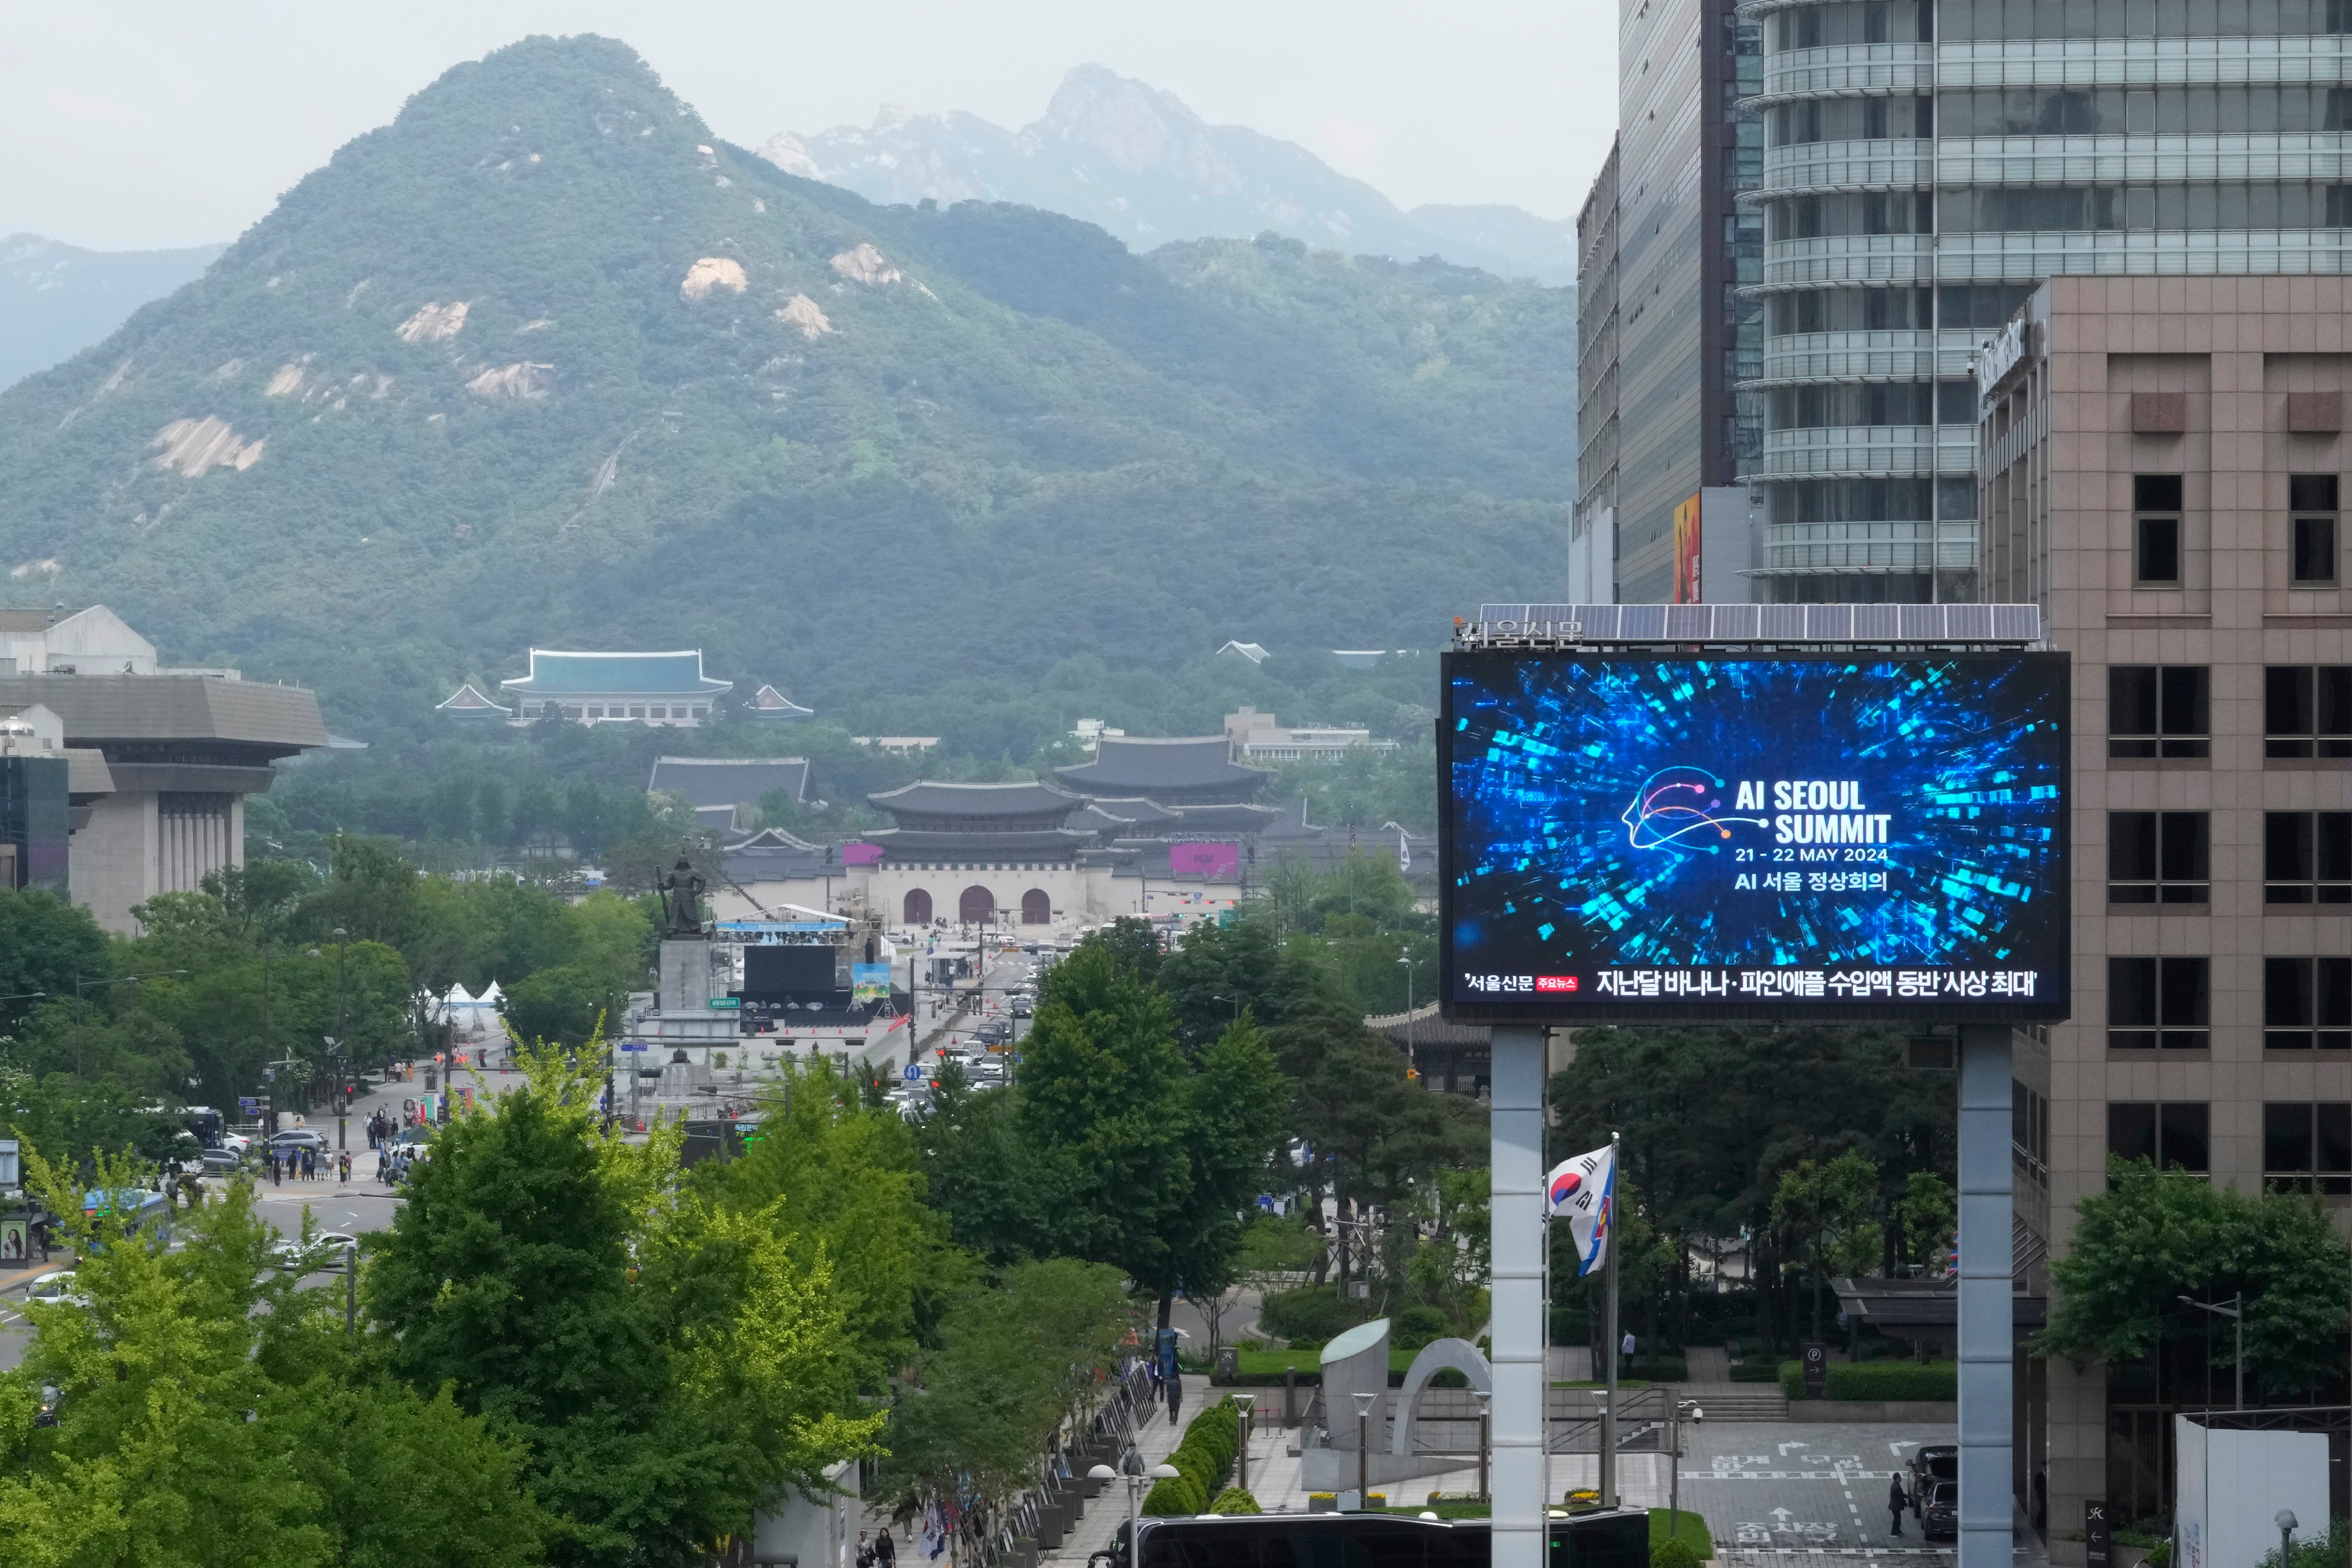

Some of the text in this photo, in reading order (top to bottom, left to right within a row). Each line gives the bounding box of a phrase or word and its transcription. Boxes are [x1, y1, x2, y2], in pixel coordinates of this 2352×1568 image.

[1460, 620, 1584, 648] 서울신문
[1735, 780, 1865, 810] AI SEOUL
[1775, 814, 1891, 843] SUMMIT
[1194, 855, 1213, 863] PGM
[1735, 848, 1754, 861] 21
[1773, 848, 1794, 861] 22
[1800, 848, 1838, 861] MAY
[1844, 848, 1888, 861] 2024
[1735, 871, 1887, 891] AI 서울 정상회의
[1538, 978, 1576, 989] 주요뉴스
[1596, 970, 1662, 996] 지난달
[1828, 970, 1892, 996] 수입액
[1896, 970, 1941, 996] 동반
[1943, 970, 1989, 996] '사상
[1991, 970, 2037, 996] 최대'
